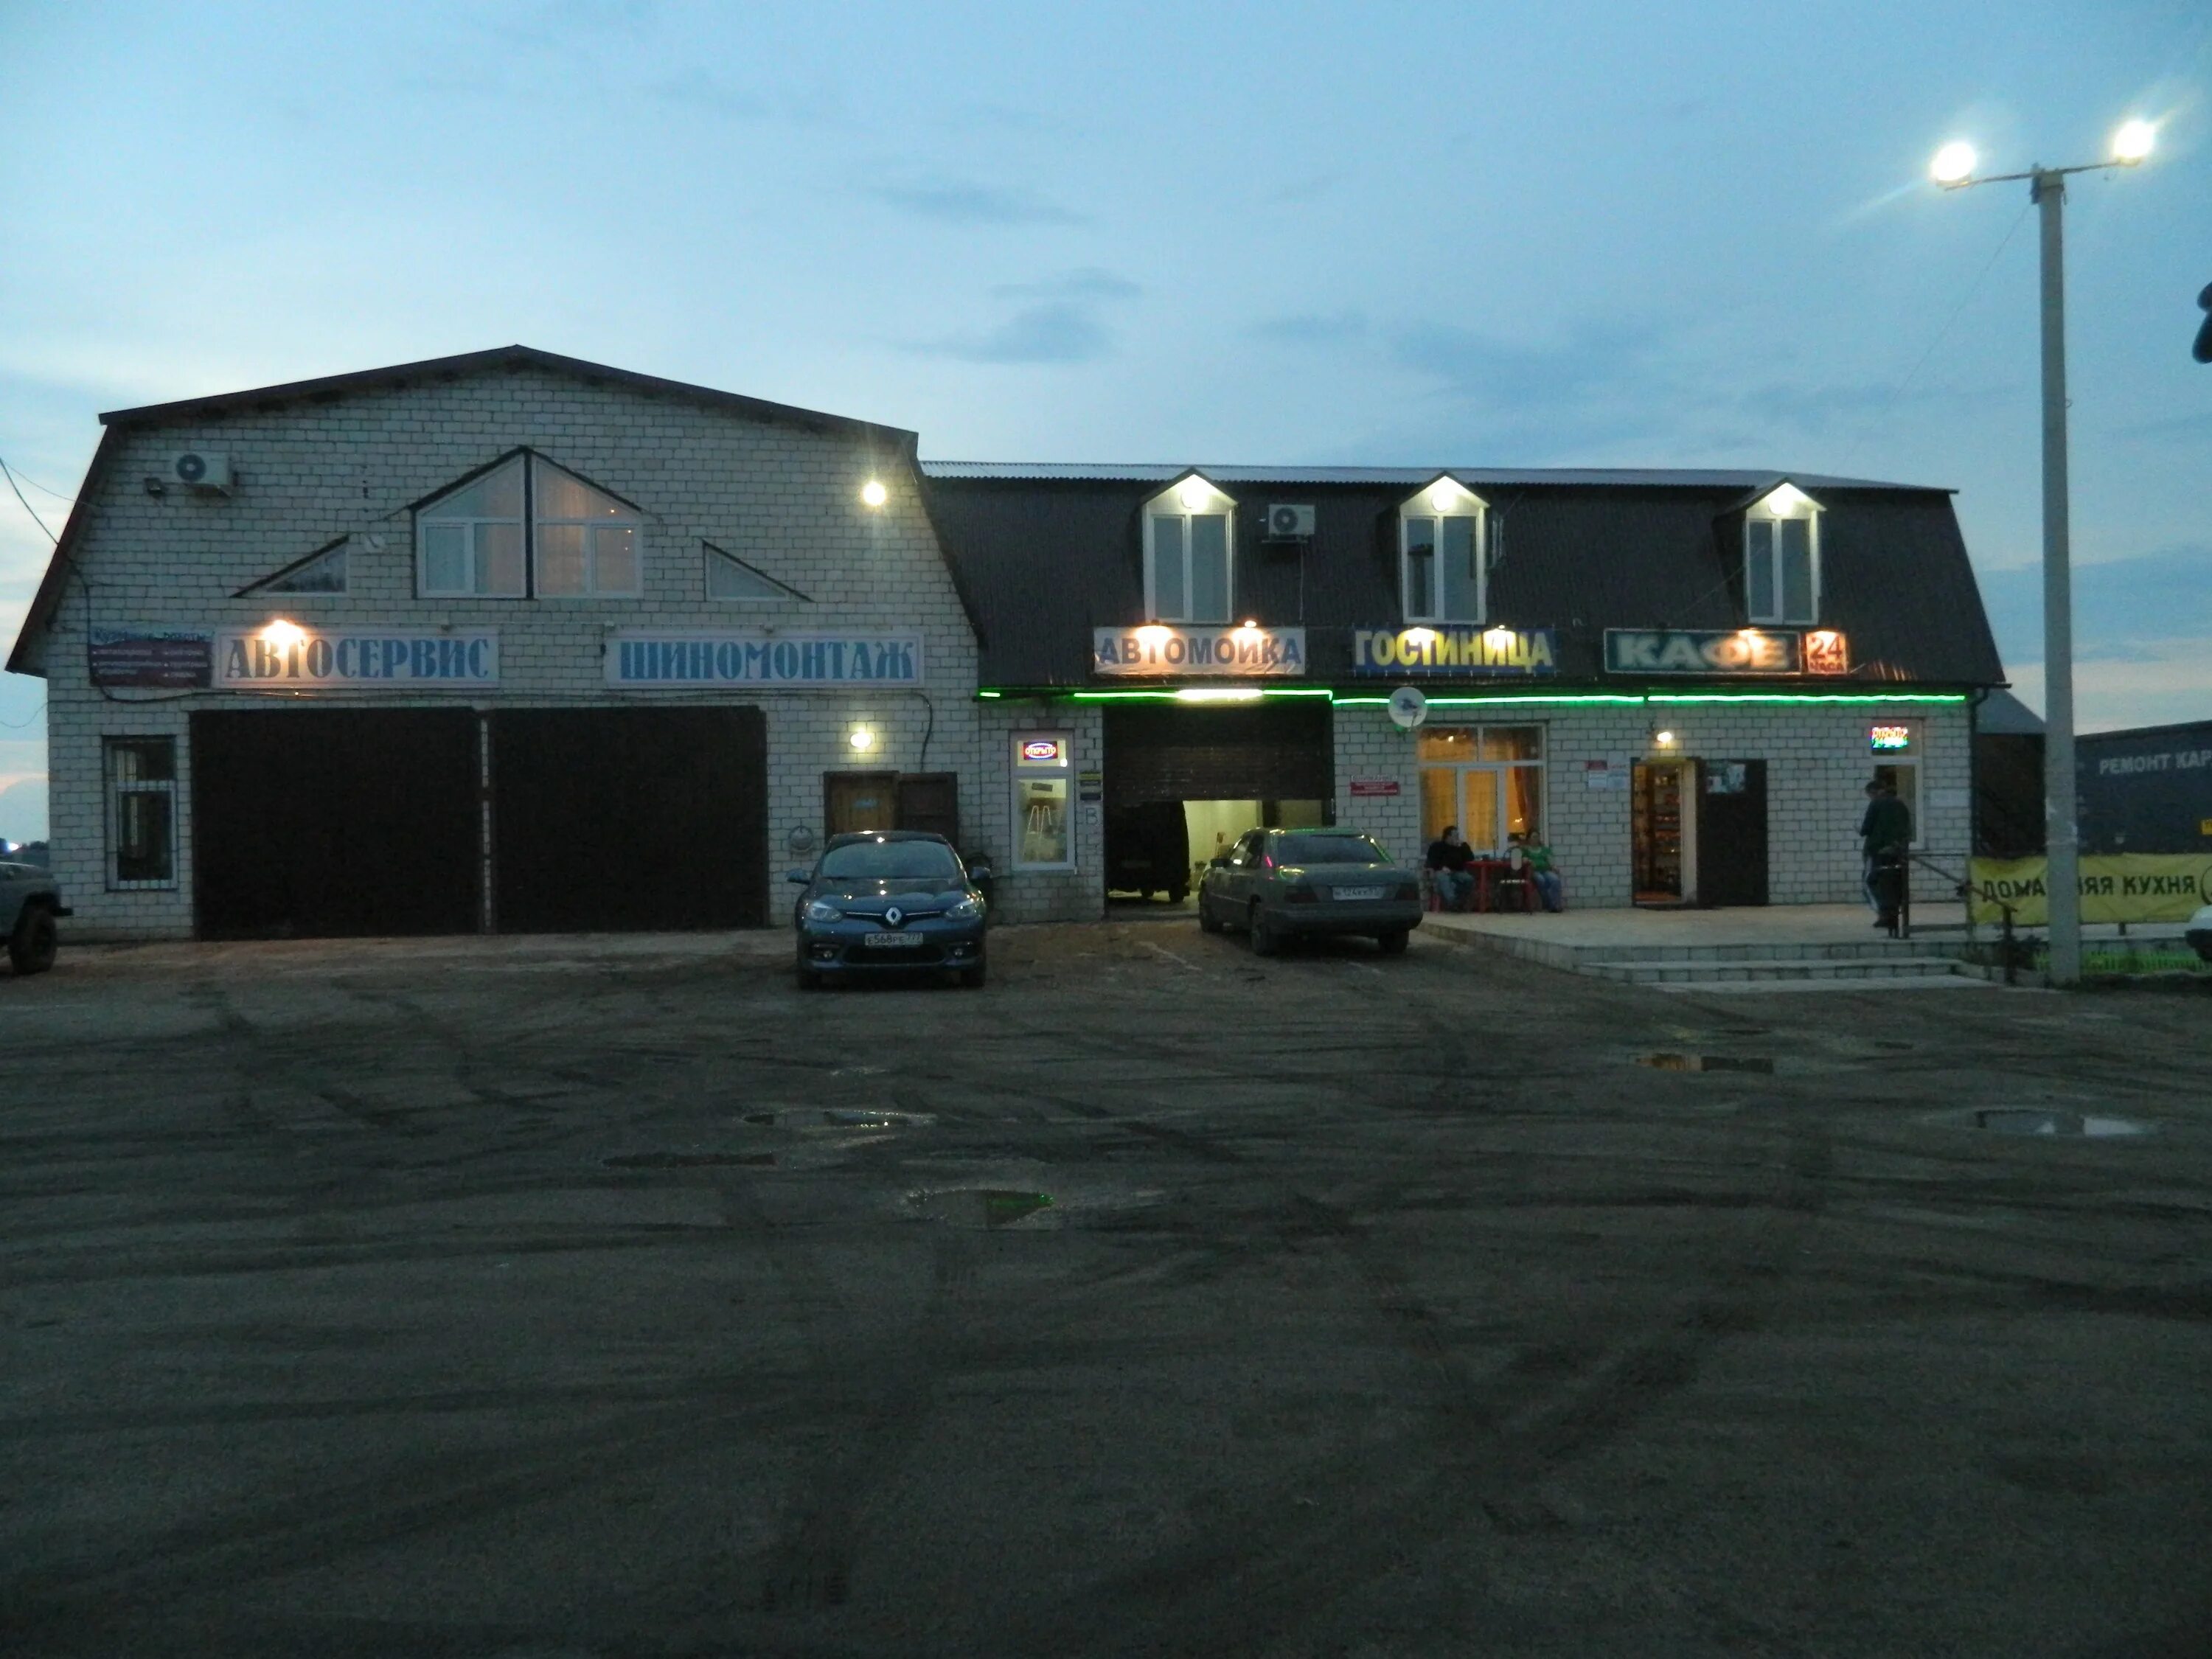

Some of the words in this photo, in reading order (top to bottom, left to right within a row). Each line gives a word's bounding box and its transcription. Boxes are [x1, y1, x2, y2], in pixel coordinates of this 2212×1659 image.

[225, 639, 489, 678] АВТОСЕРВИС
[619, 641, 914, 680] ШИНОМОНТАЖ
[1355, 629, 1553, 673] ГОСТИНИЦА
[1617, 633, 1787, 669] КАФЕ
[1809, 635, 1843, 660] 24
[2099, 754, 2171, 775] РЕМОНТ
[2175, 749, 2212, 769] КАР
[1982, 876, 2113, 902] ДОМАЯЯ
[2123, 875, 2197, 896] КУХНЯ
